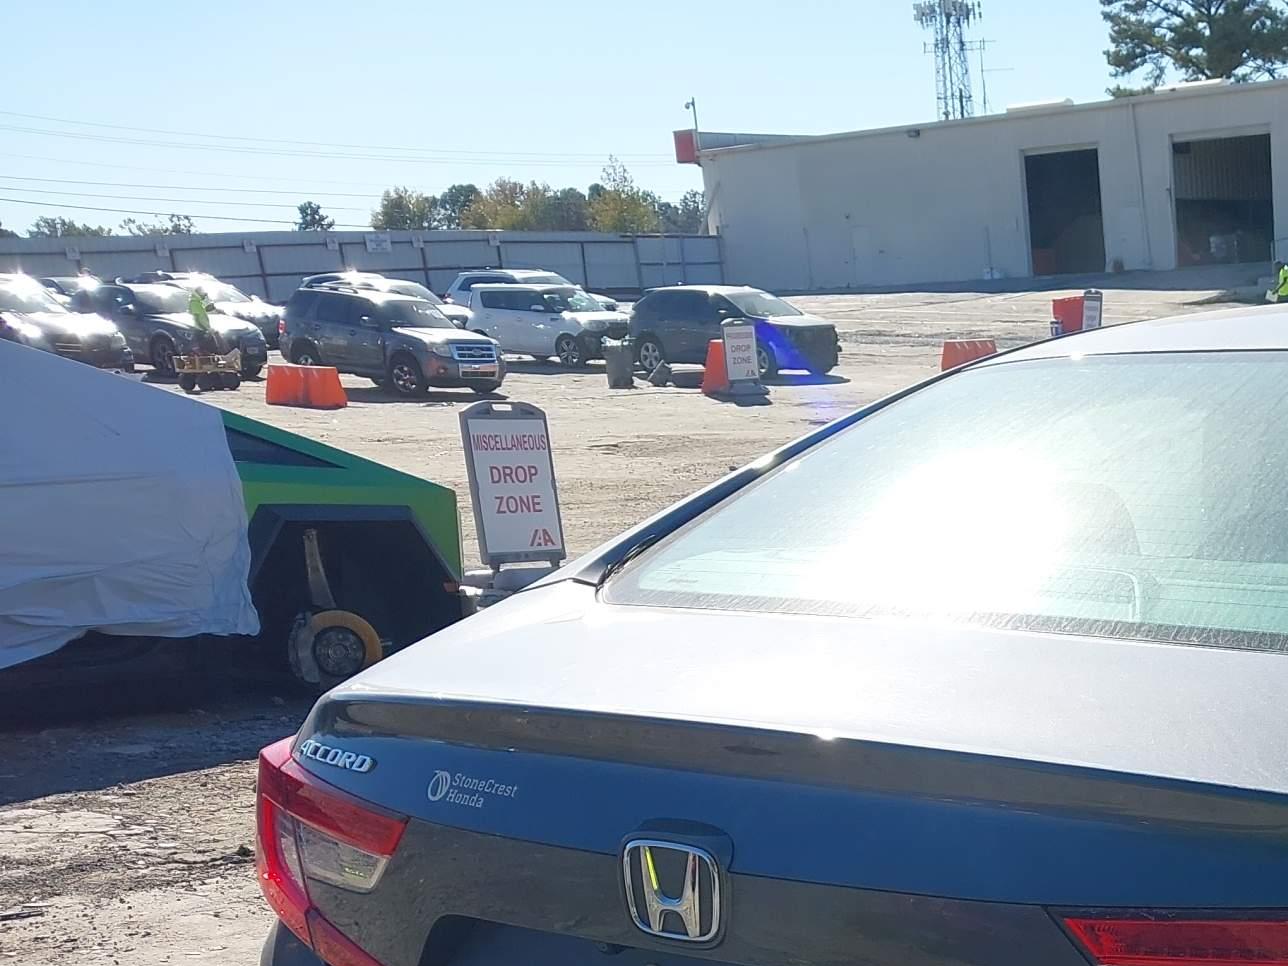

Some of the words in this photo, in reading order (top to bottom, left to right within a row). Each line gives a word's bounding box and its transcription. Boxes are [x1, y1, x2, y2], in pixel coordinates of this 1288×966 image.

[472, 434, 547, 451] MISCELLANEOUS
[489, 465, 538, 484] DROP
[494, 495, 543, 514] ZONE
[301, 739, 373, 773] ACCORD
[452, 773, 518, 798] StoneCrest
[446, 789, 484, 808] Honda
